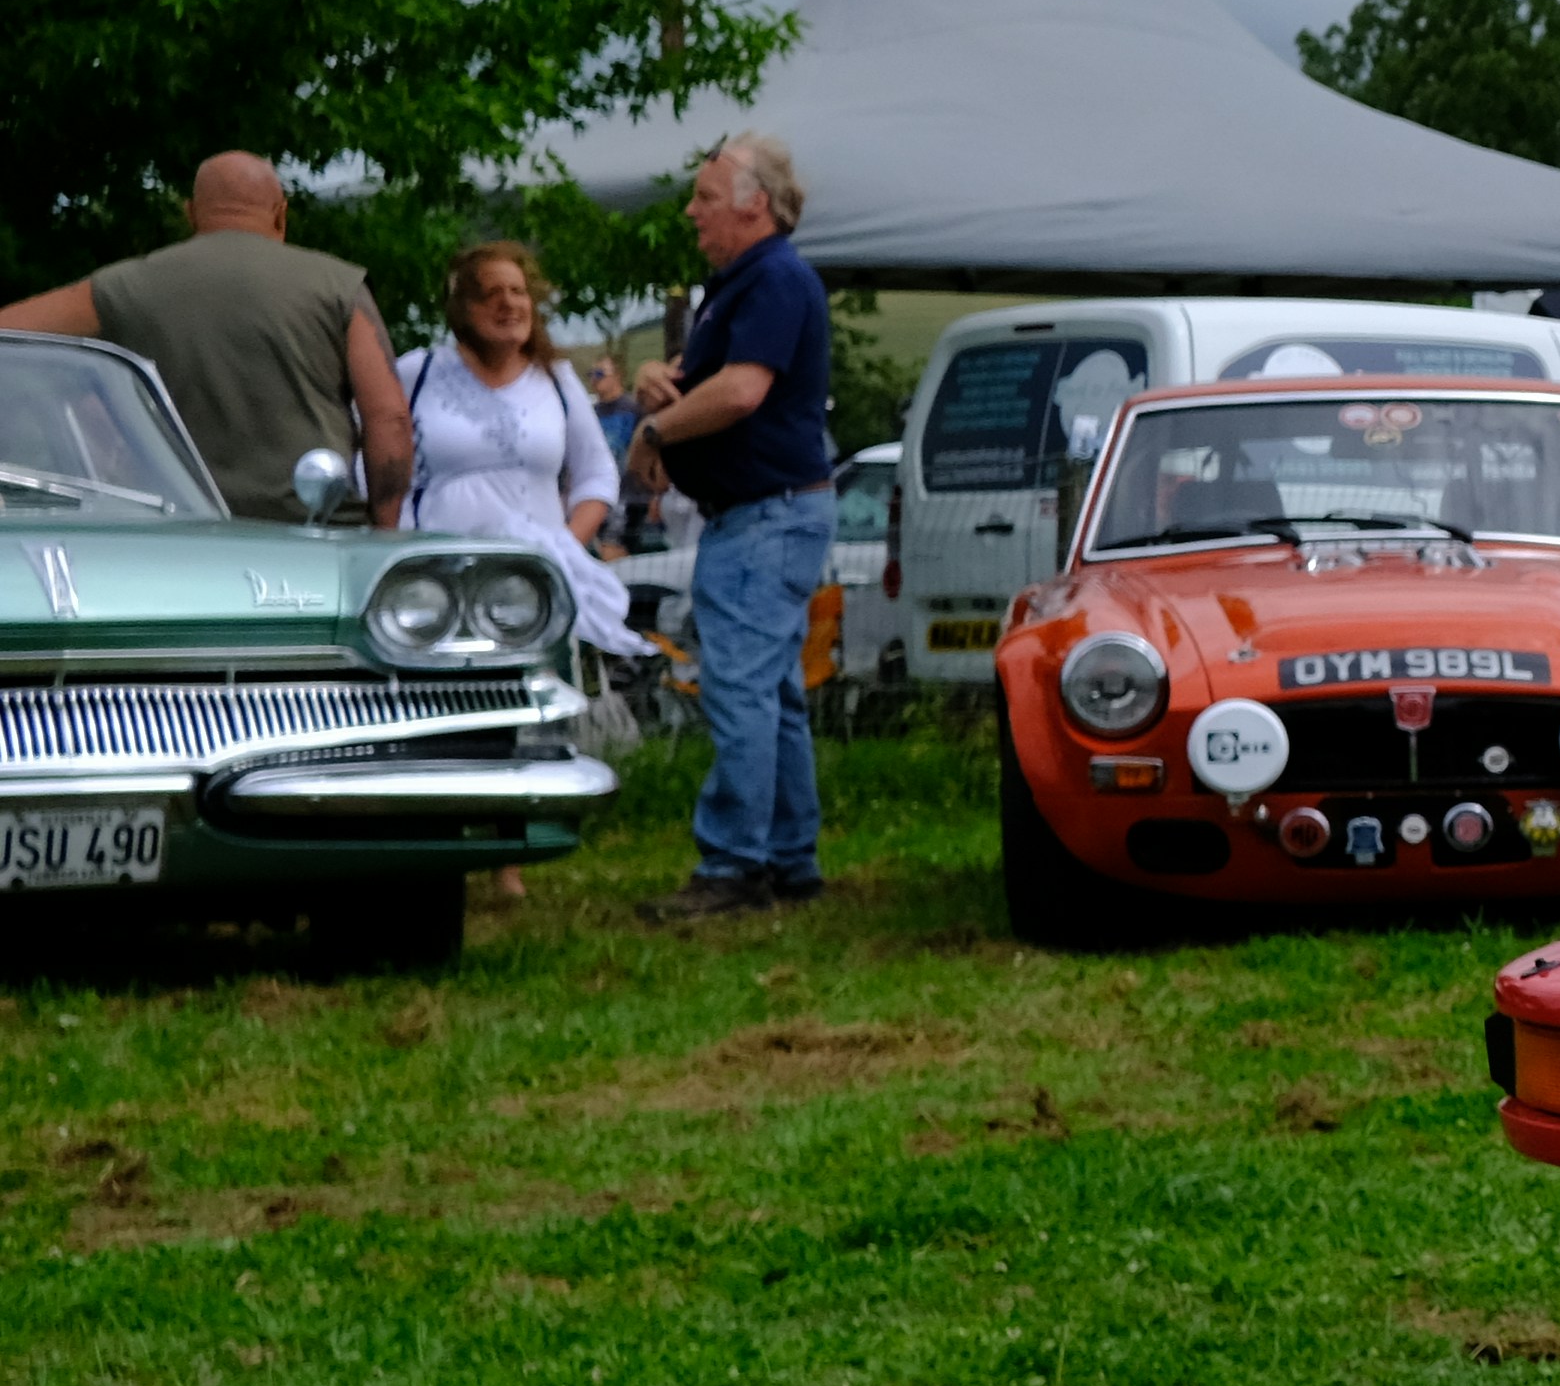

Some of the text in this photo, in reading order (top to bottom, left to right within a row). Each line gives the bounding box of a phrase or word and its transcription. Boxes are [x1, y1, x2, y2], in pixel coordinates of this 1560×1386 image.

[1293, 648, 1534, 686] OYM 989L
[86, 824, 160, 871] 490
